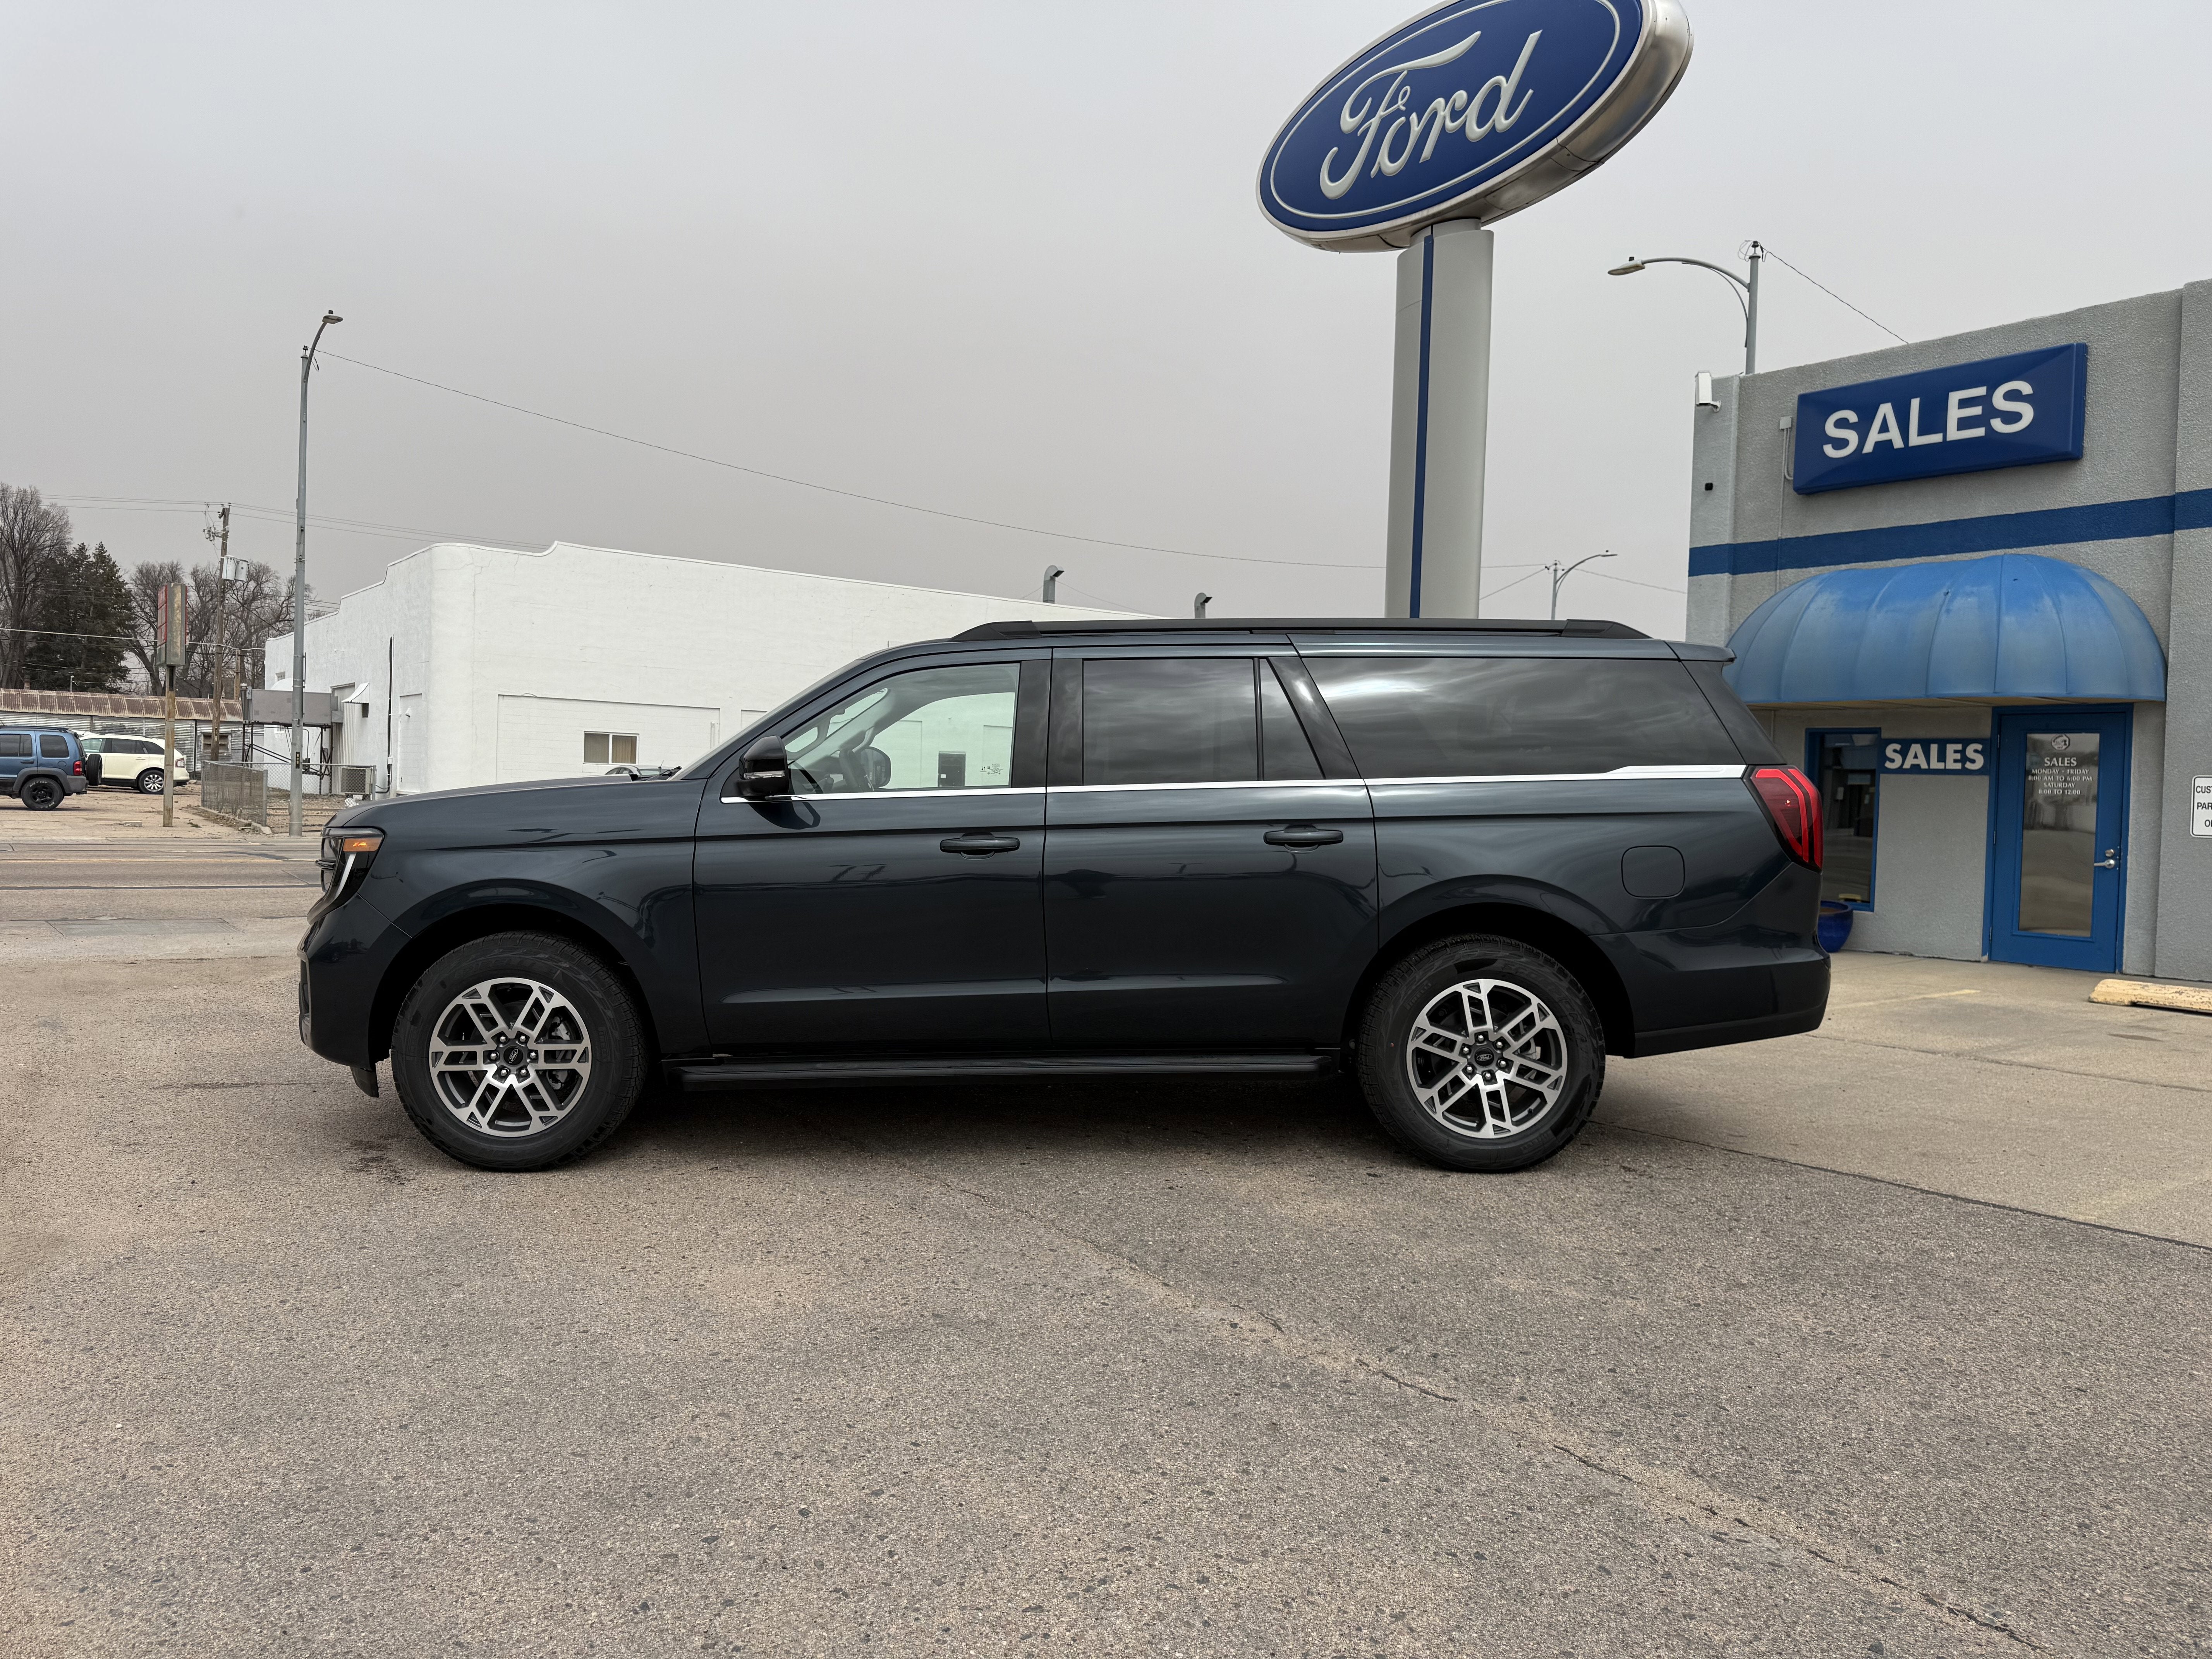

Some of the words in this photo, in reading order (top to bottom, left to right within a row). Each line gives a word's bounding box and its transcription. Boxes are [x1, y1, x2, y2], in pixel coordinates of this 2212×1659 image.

[1320, 30, 1542, 200] Ford
[1823, 380, 2034, 459] SALES
[1884, 743, 1984, 770] SALES
[2044, 757, 2077, 767] SALES
